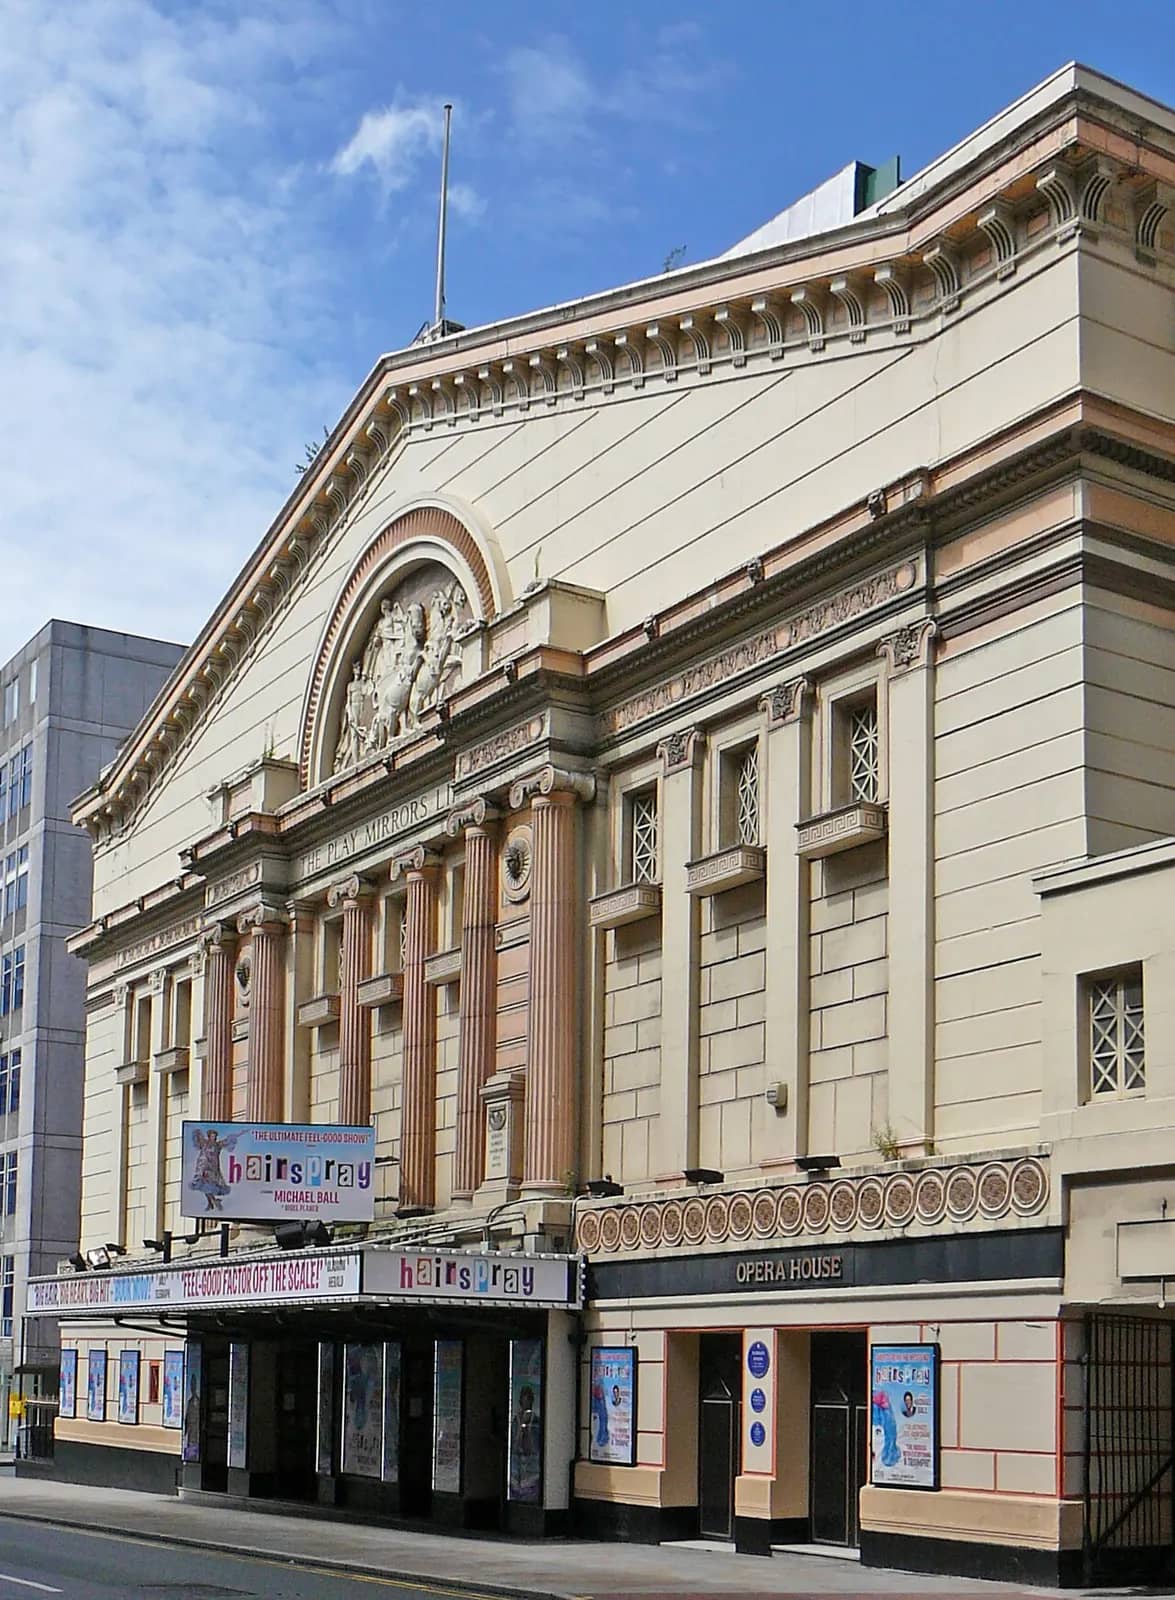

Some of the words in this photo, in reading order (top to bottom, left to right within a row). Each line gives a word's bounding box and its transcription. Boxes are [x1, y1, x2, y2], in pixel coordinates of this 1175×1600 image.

[301, 853, 322, 874] THE
[327, 831, 358, 864] PLAY
[365, 796, 428, 845] MIRRORS
[436, 783, 450, 811] LI
[268, 1131, 303, 1143] ULTIMATE
[228, 1154, 371, 1189] hairspray
[274, 1191, 316, 1205] MICHAEL
[317, 1192, 340, 1205] BALL
[222, 1265, 251, 1296] FACTOR
[252, 1262, 270, 1293] OFF
[270, 1260, 287, 1291] THE
[400, 1257, 534, 1296] hairspray
[736, 1261, 786, 1282] OPERA
[790, 1255, 841, 1279] HOUSE
